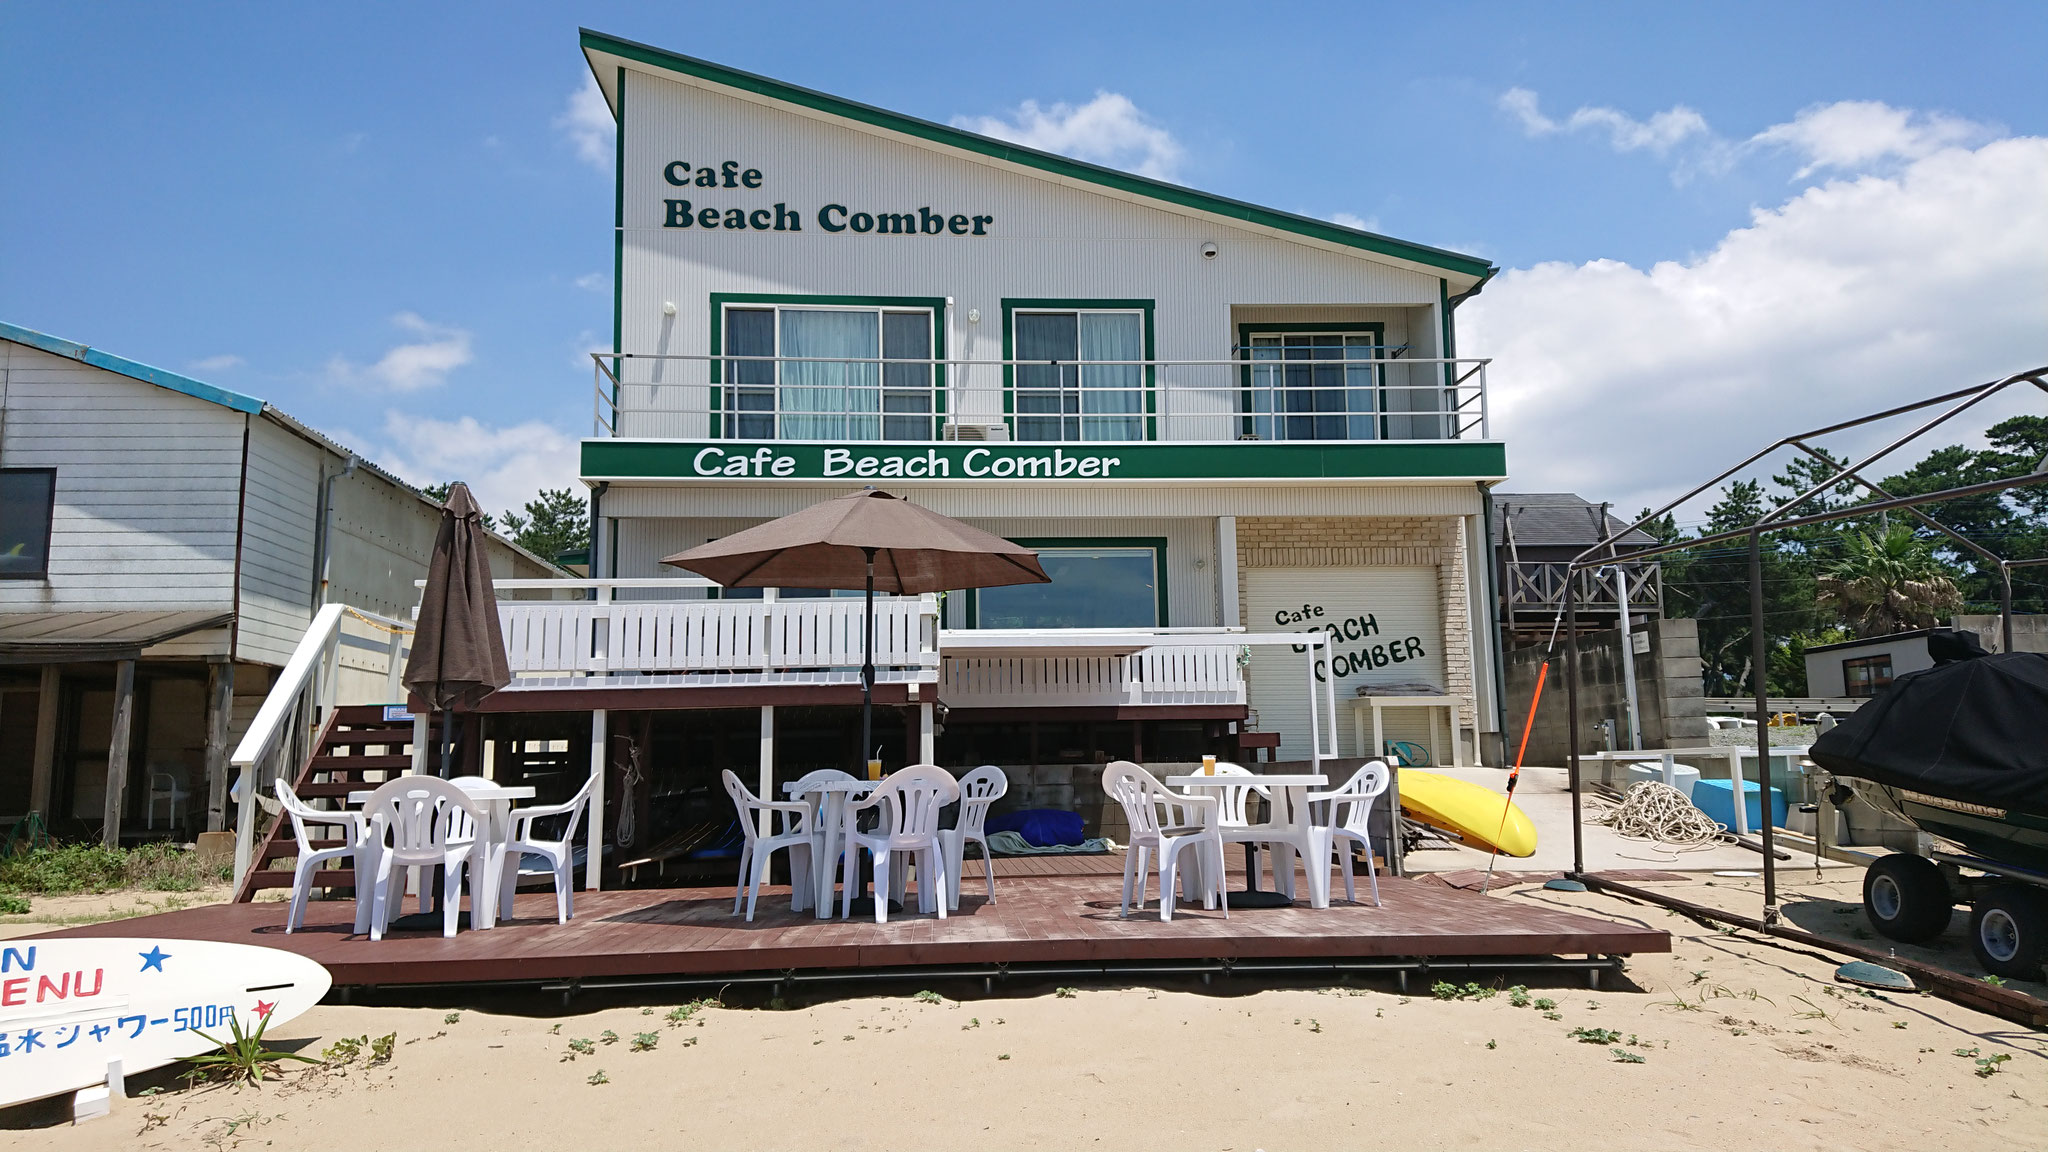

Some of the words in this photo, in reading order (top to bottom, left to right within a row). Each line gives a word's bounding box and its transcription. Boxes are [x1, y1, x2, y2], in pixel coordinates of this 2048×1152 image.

[663, 160, 763, 189] Cafe
[663, 199, 802, 232] Beach
[818, 203, 994, 237] Comber
[693, 447, 796, 477] Cafe
[822, 448, 949, 477] Beach
[963, 448, 1121, 477] Comber
[1275, 604, 1325, 626] Cafe
[1314, 636, 1426, 683] COMBER
